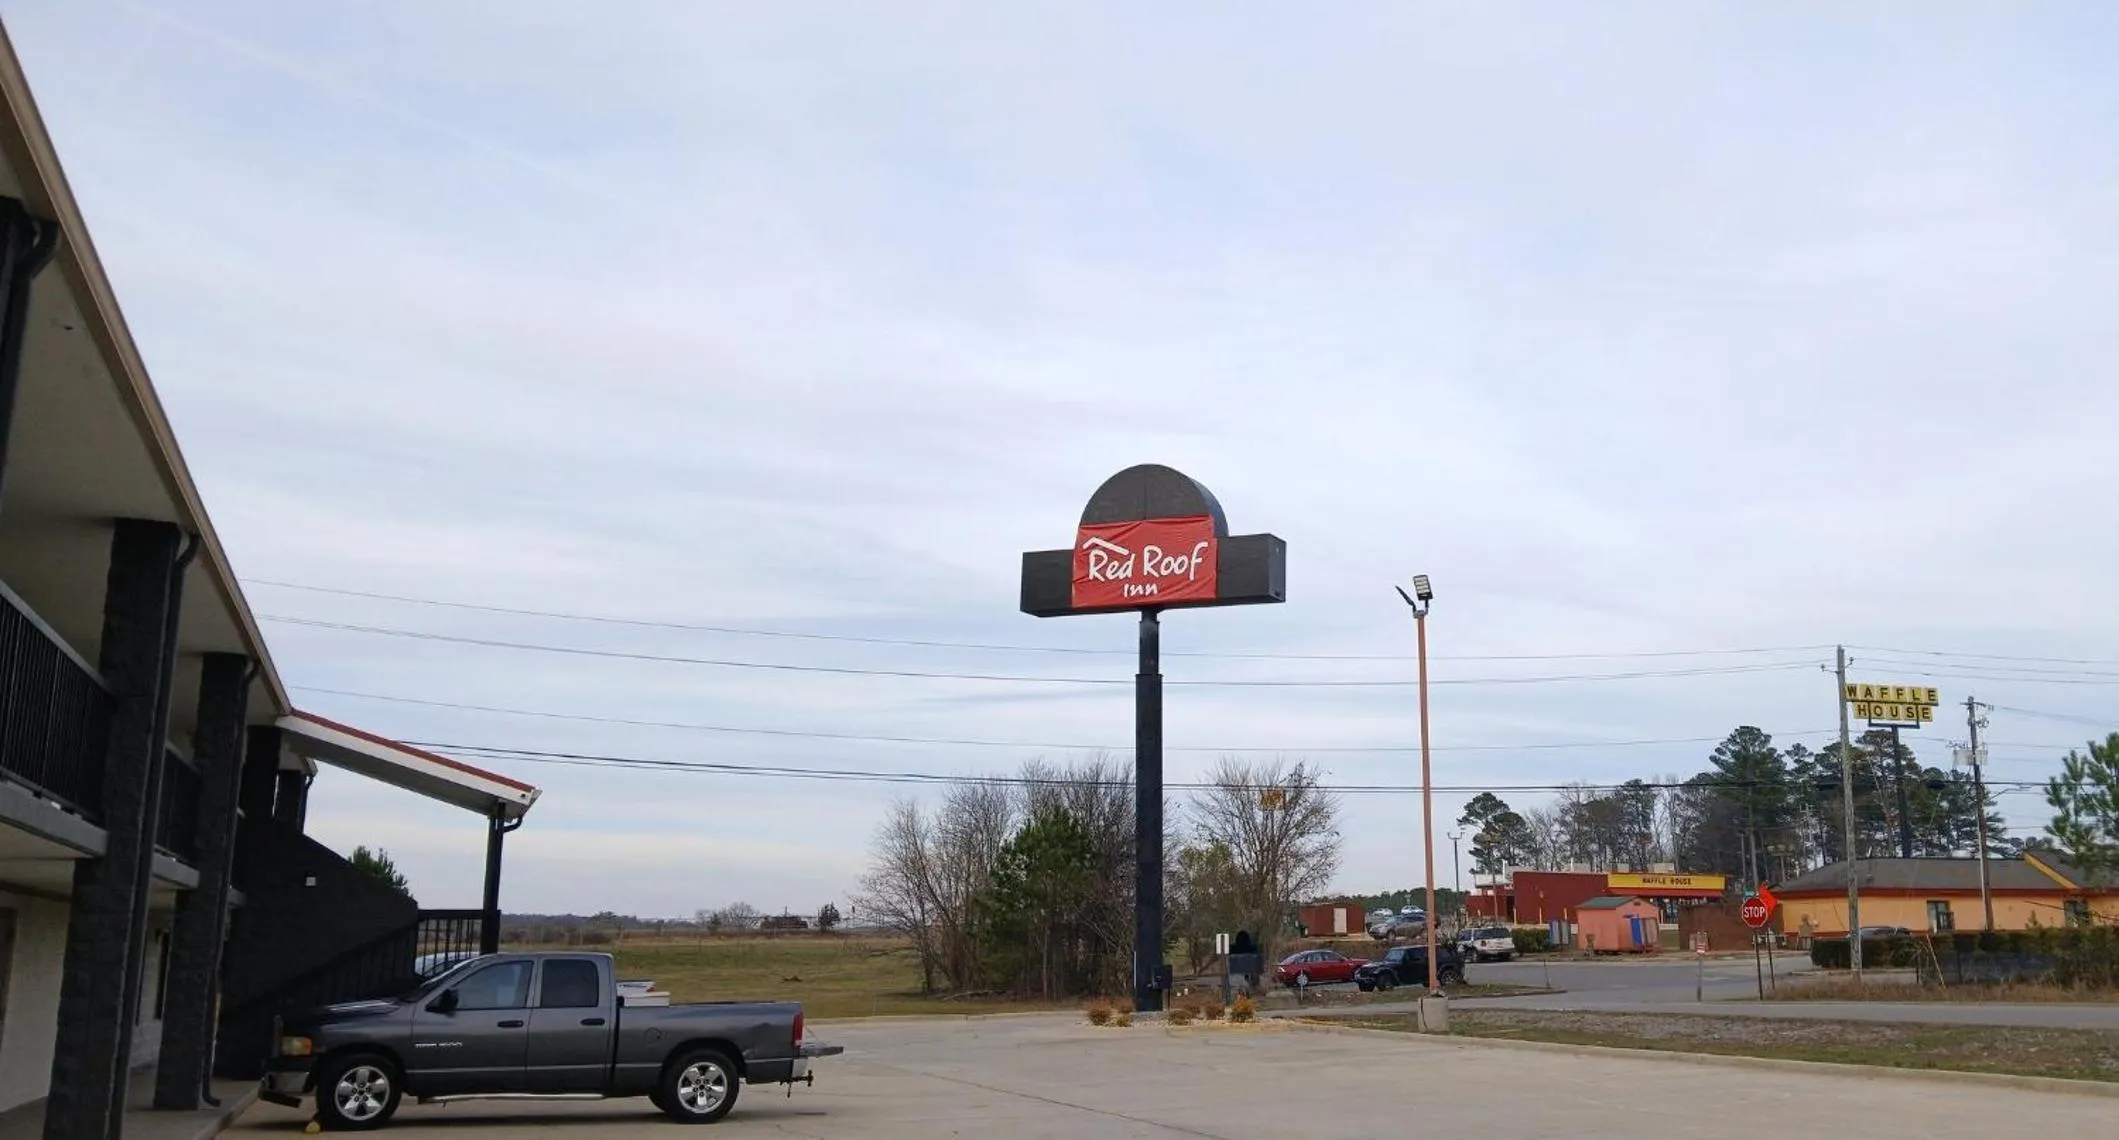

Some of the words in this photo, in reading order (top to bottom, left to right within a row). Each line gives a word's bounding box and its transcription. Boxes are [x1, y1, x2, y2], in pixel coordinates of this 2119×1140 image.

[1089, 549, 1136, 582] Red
[1143, 541, 1209, 581] Roof
[1847, 685, 1937, 701] WAFFLE
[1857, 704, 1931, 720] HOUSE
[1744, 906, 1765, 918] STOP
